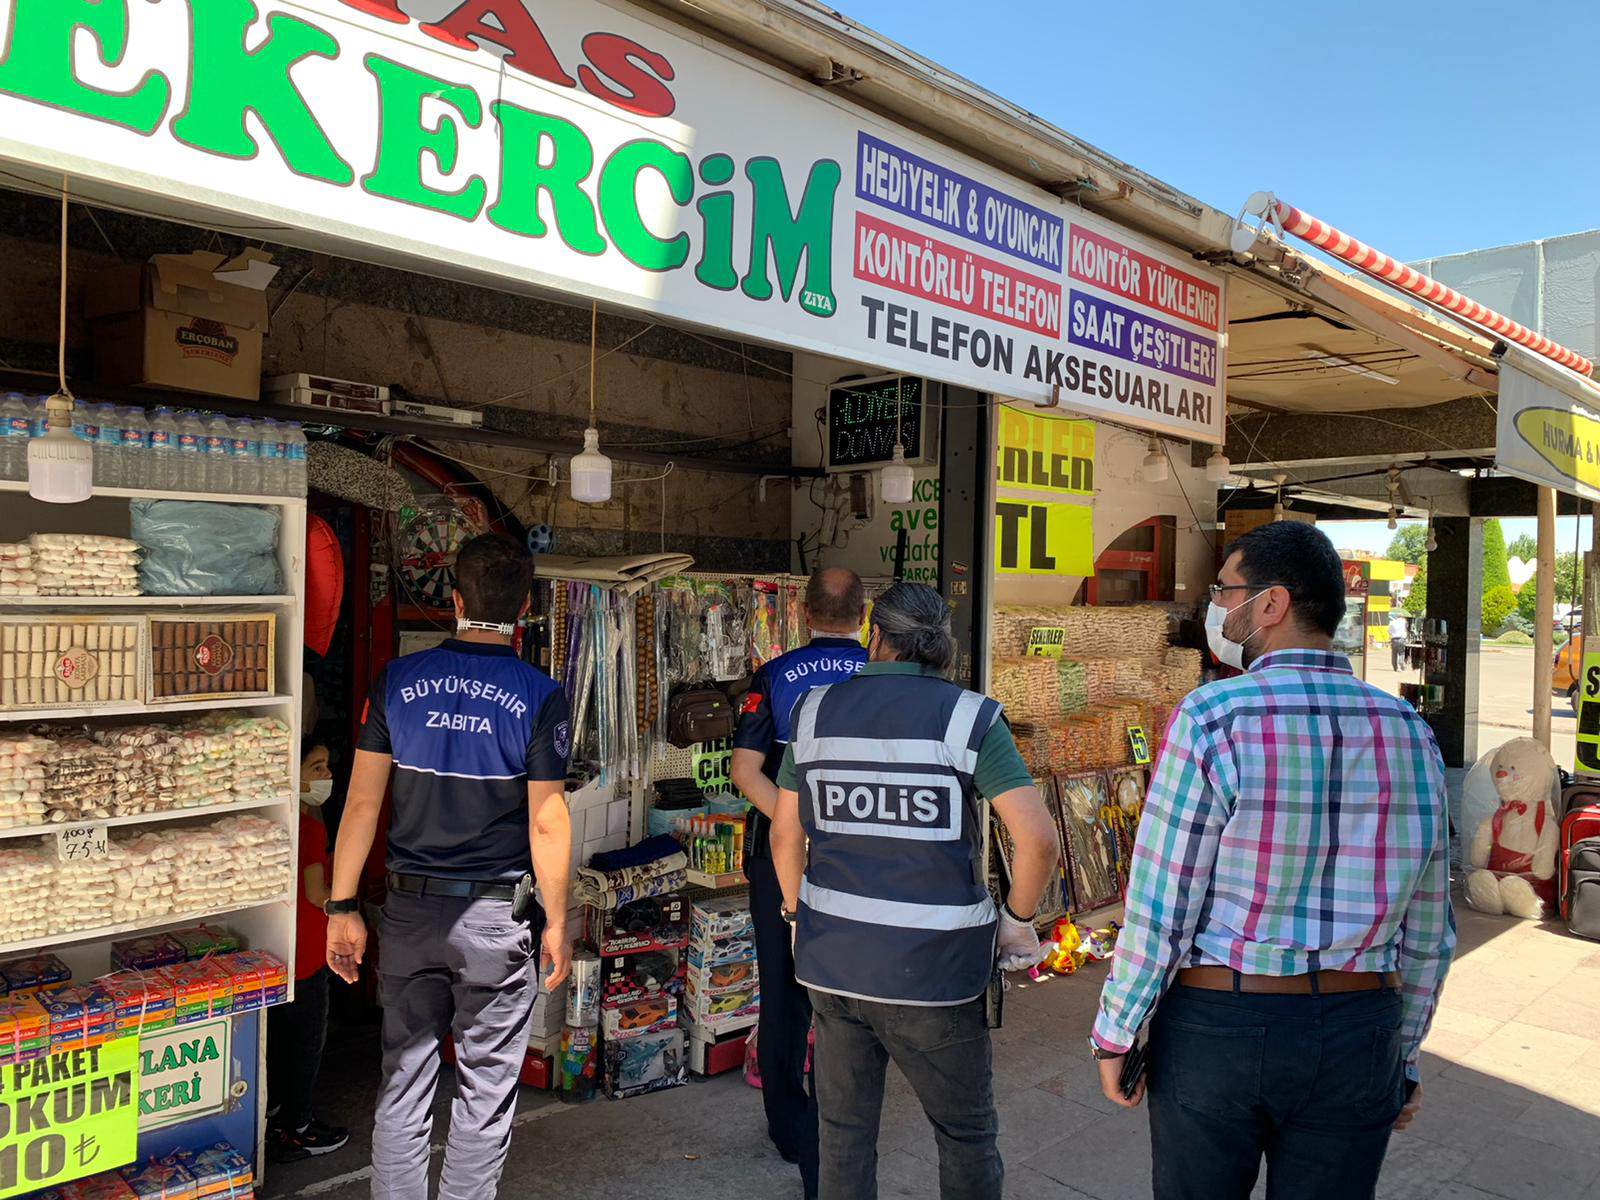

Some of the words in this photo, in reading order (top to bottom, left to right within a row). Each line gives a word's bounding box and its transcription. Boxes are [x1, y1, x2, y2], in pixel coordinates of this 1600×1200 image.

[337, 0, 676, 118] AS
[966, 188, 979, 234] &
[984, 196, 1060, 266] OYUNCAK
[859, 226, 975, 305] KONTÖRLÜ
[981, 268, 1059, 332] TELEFON
[1071, 235, 1141, 298] KONTÖR
[181, 330, 234, 349] ERÇOBAN
[1072, 299, 1125, 350] SAAT
[861, 295, 1013, 375] TELEFON
[1023, 344, 1212, 425] AKSESUARLARI
[996, 410, 1094, 491] RLER
[1543, 420, 1583, 461] HURMA
[1586, 440, 1594, 464] &
[996, 502, 1056, 570] TL
[400, 676, 527, 719] BÜYÜKŞEHİR
[425, 711, 493, 735] ZABITA
[1130, 727, 1148, 761] 5
[13, 1044, 103, 1092] PAKET
[139, 1036, 220, 1077] LANA
